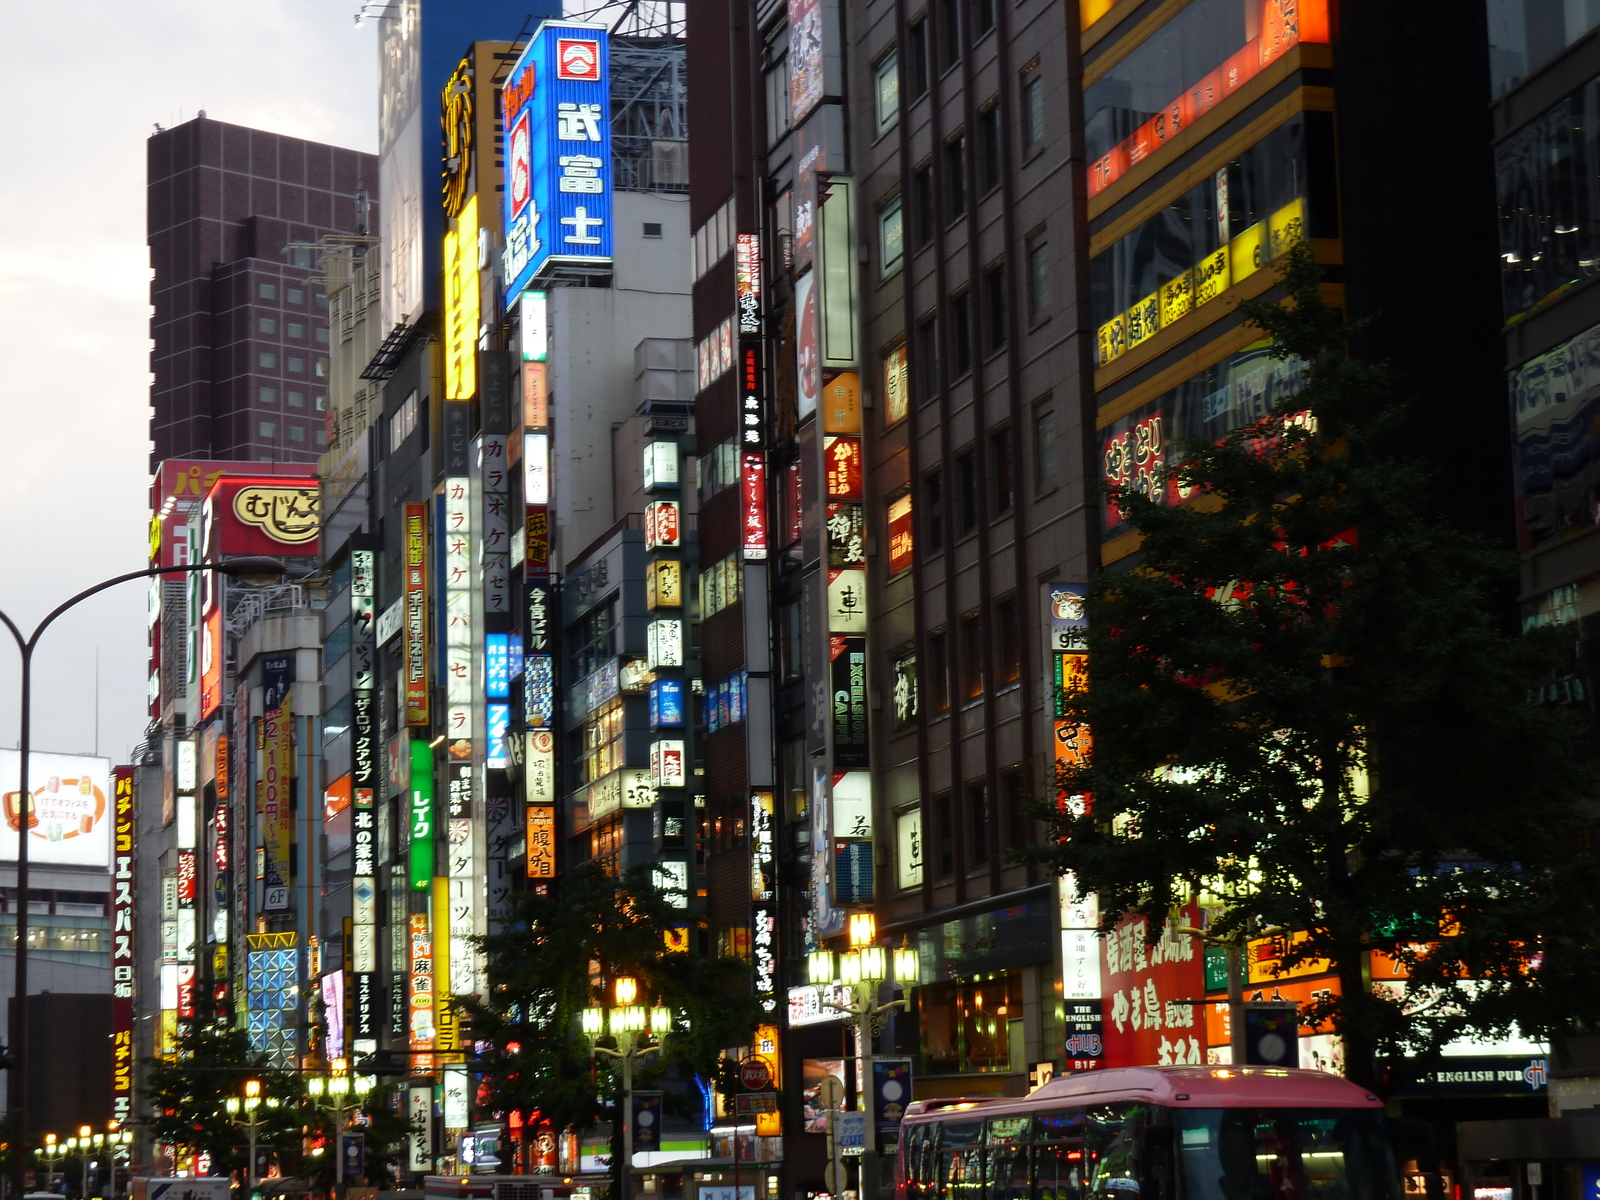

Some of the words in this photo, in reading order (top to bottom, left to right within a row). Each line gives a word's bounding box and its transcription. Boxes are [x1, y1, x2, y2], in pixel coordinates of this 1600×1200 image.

[558, 103, 604, 245] 武富士
[1094, 155, 1111, 191] 7F
[738, 234, 750, 243] 9F
[487, 362, 502, 423] 水上ビル
[450, 409, 463, 467] 水上ビル
[834, 442, 853, 495] かまどか
[747, 474, 762, 528] さくら坂
[526, 512, 548, 563] 麻雀
[449, 484, 467, 729] カラオケパセラ
[528, 588, 548, 651] 今宮ビル
[408, 589, 423, 683] インターネット
[497, 645, 508, 691] カラオケ
[834, 690, 850, 745] CAFFÉ
[849, 652, 864, 745] EXCELSIOR
[354, 697, 373, 783] ザ・ロックアップ
[489, 705, 507, 757] 747
[41, 798, 89, 809] ITでオフィスを
[281, 775, 289, 830] 飲み放題付
[449, 780, 462, 816] 営業中
[460, 766, 472, 801] 朝まで
[41, 809, 77, 820] 元気にする
[116, 777, 133, 851] パチンコ
[414, 791, 430, 838] レイク
[354, 811, 374, 876] 北の家族
[530, 828, 552, 875] 腹八分目
[269, 889, 286, 904] 6F
[416, 880, 428, 888] 4F
[453, 855, 471, 921] ダーツ
[759, 890, 773, 900] 3F
[114, 856, 133, 998] エスパス日拓
[452, 926, 471, 934] BAR
[490, 909, 509, 917] BAR
[412, 959, 433, 992] 麻雀
[1075, 934, 1087, 990] 築地すし好
[359, 974, 370, 1034] ミステリアス
[1065, 1014, 1101, 1022] ENGLISH
[1075, 1023, 1092, 1031] PUB
[1111, 978, 1162, 1034] やき鳥
[114, 1030, 131, 1090] パチンコ
[1065, 1033, 1102, 1056] HUB
[1074, 1061, 1097, 1069] B1F
[743, 1069, 768, 1081] 消火栓
[1436, 1070, 1495, 1083] ENGLISH
[1497, 1069, 1524, 1082] PUB
[842, 1126, 864, 1135] タクシ
